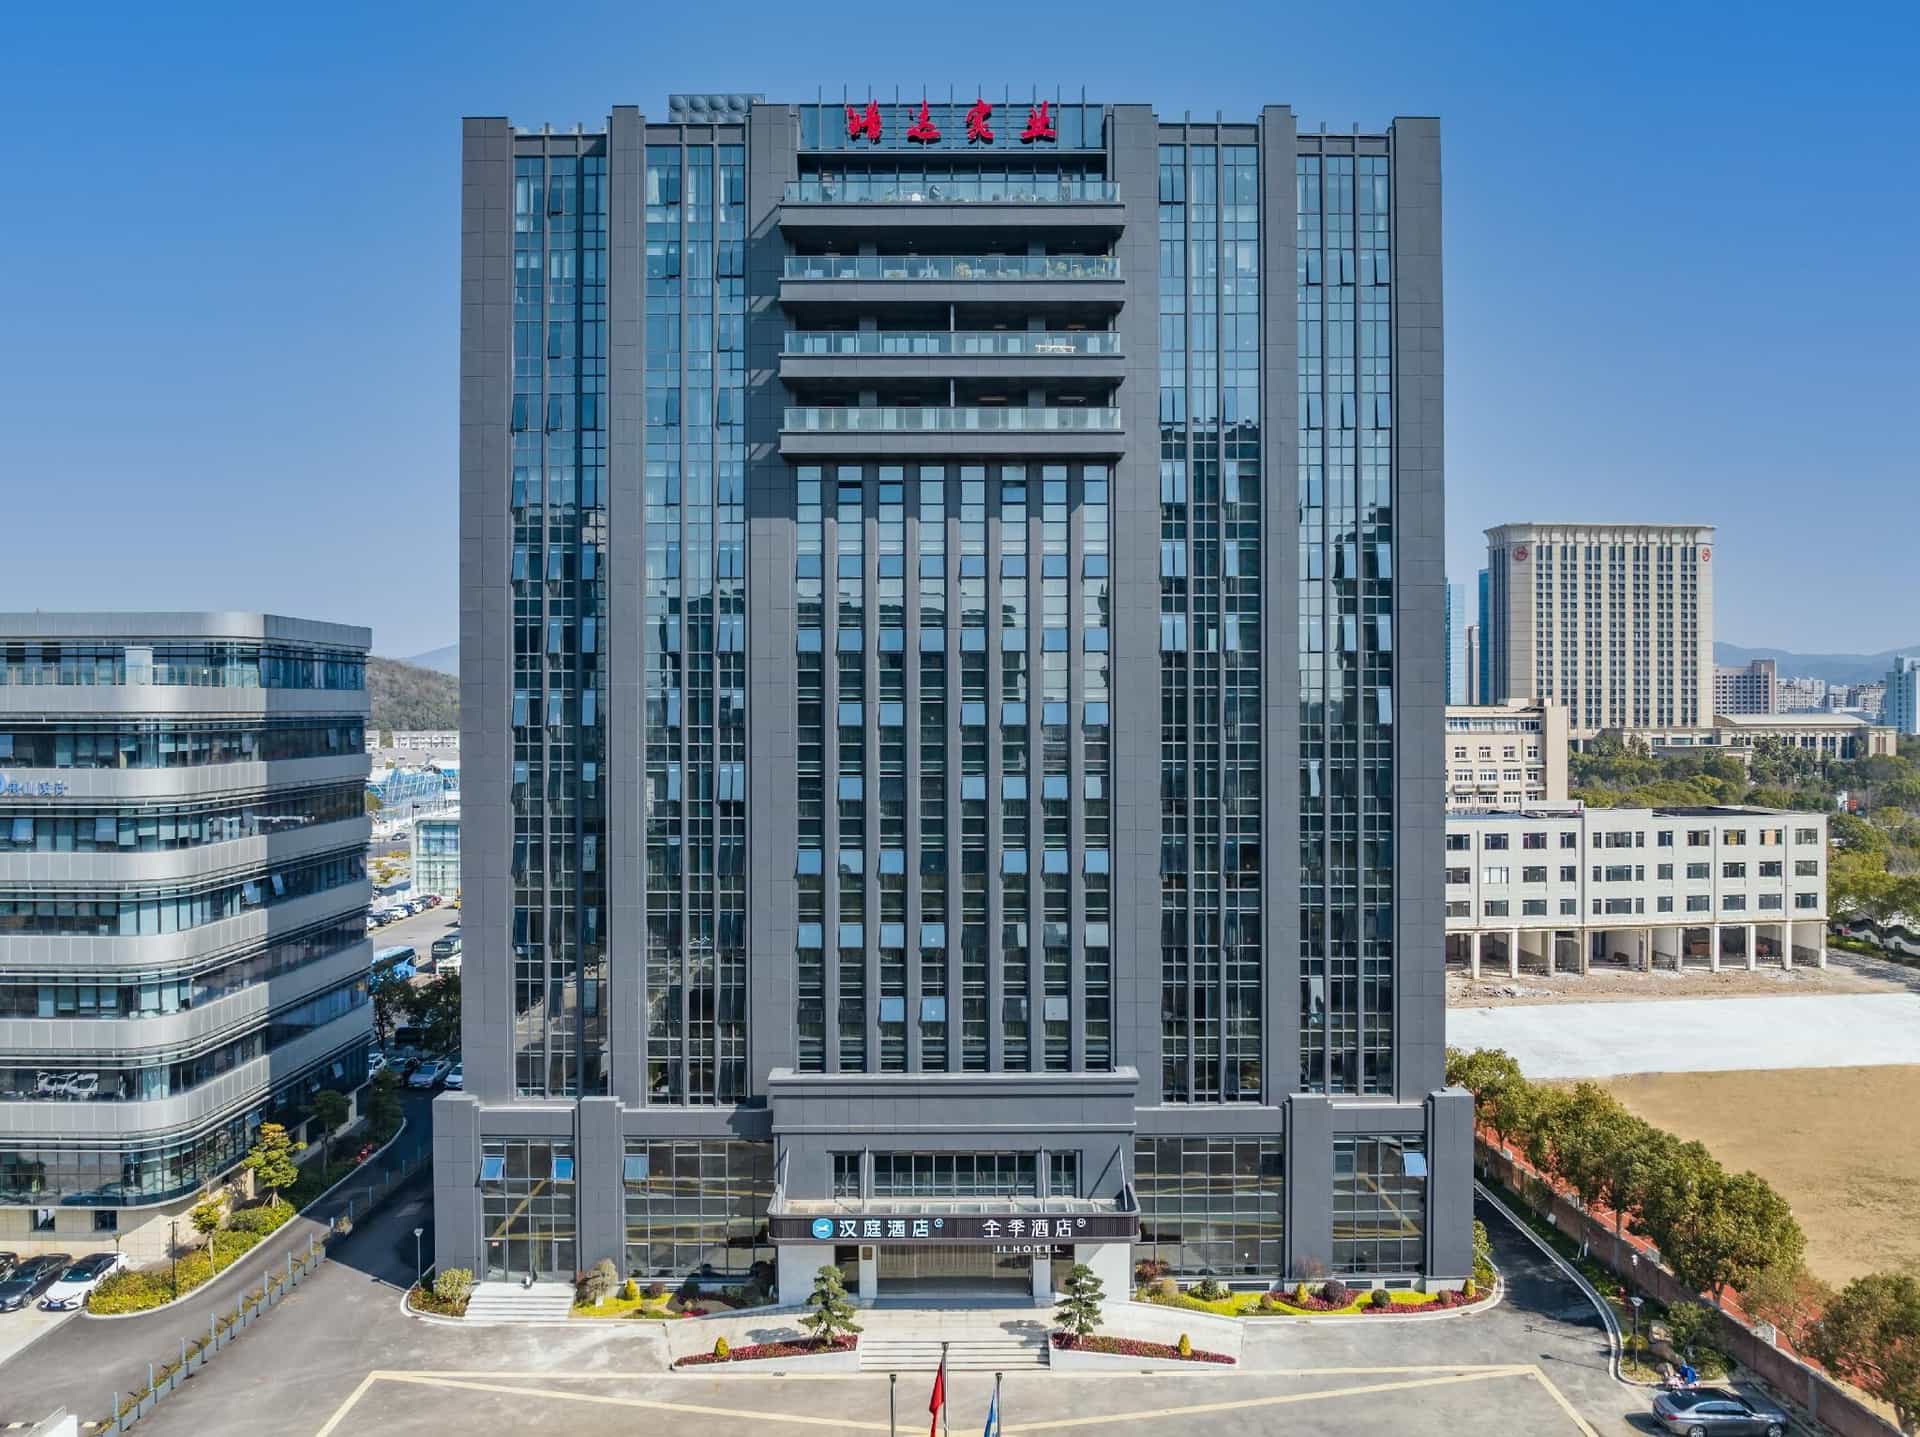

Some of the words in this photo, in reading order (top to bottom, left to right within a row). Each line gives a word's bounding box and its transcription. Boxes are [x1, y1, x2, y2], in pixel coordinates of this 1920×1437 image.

[839, 1219, 929, 1238] 汉庭酒店
[982, 1219, 1072, 1238] 全季酒店
[1013, 1245, 1062, 1254] HOTEL
